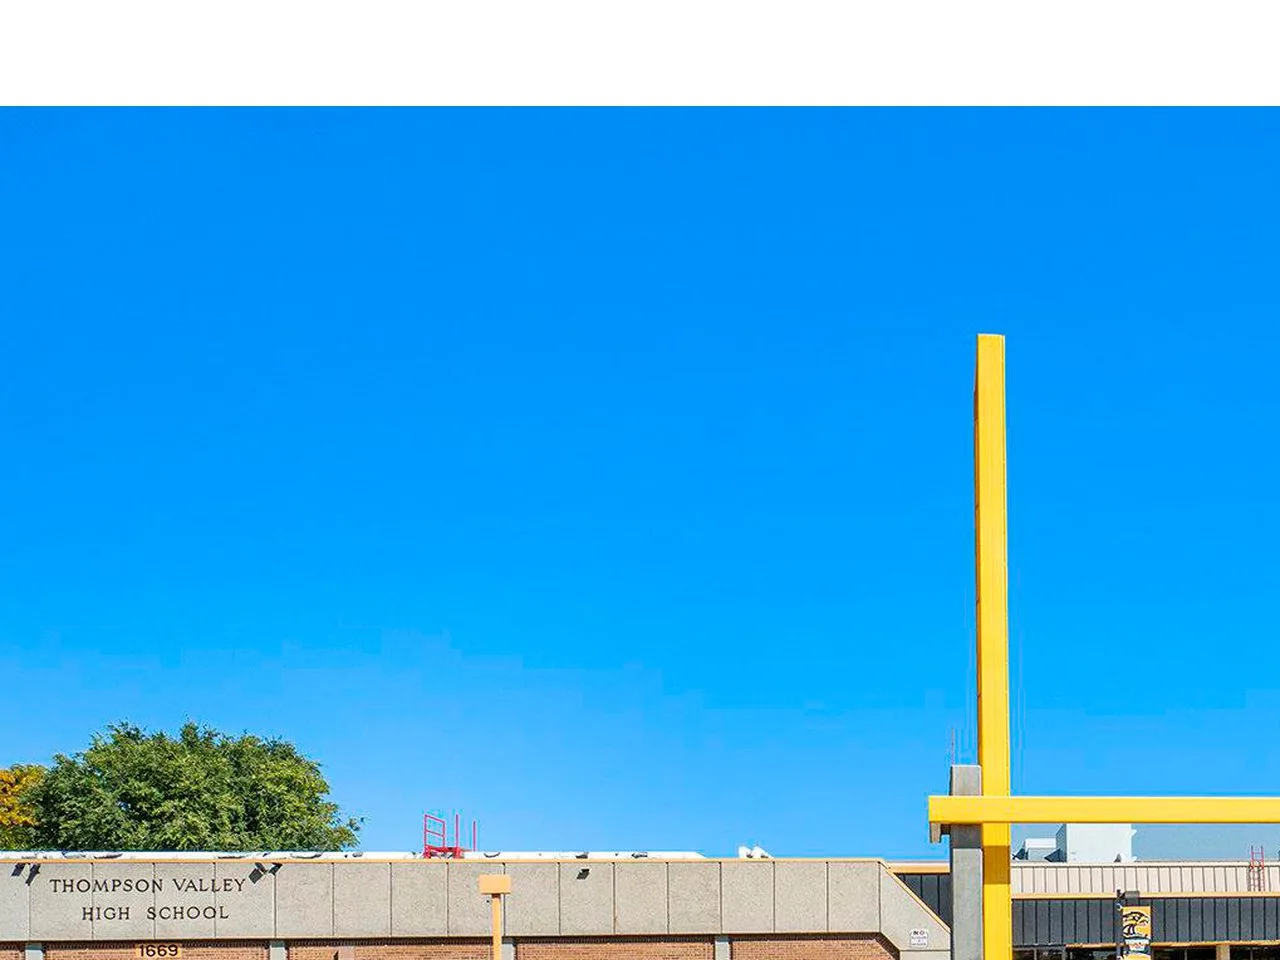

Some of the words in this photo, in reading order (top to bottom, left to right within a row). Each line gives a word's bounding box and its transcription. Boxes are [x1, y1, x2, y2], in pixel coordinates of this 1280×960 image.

[49, 878, 164, 893] THOMPSON
[172, 878, 247, 893] VALLEY
[81, 906, 131, 922] HIGH
[146, 905, 230, 921] SCHOOL
[139, 944, 179, 957] 1669
